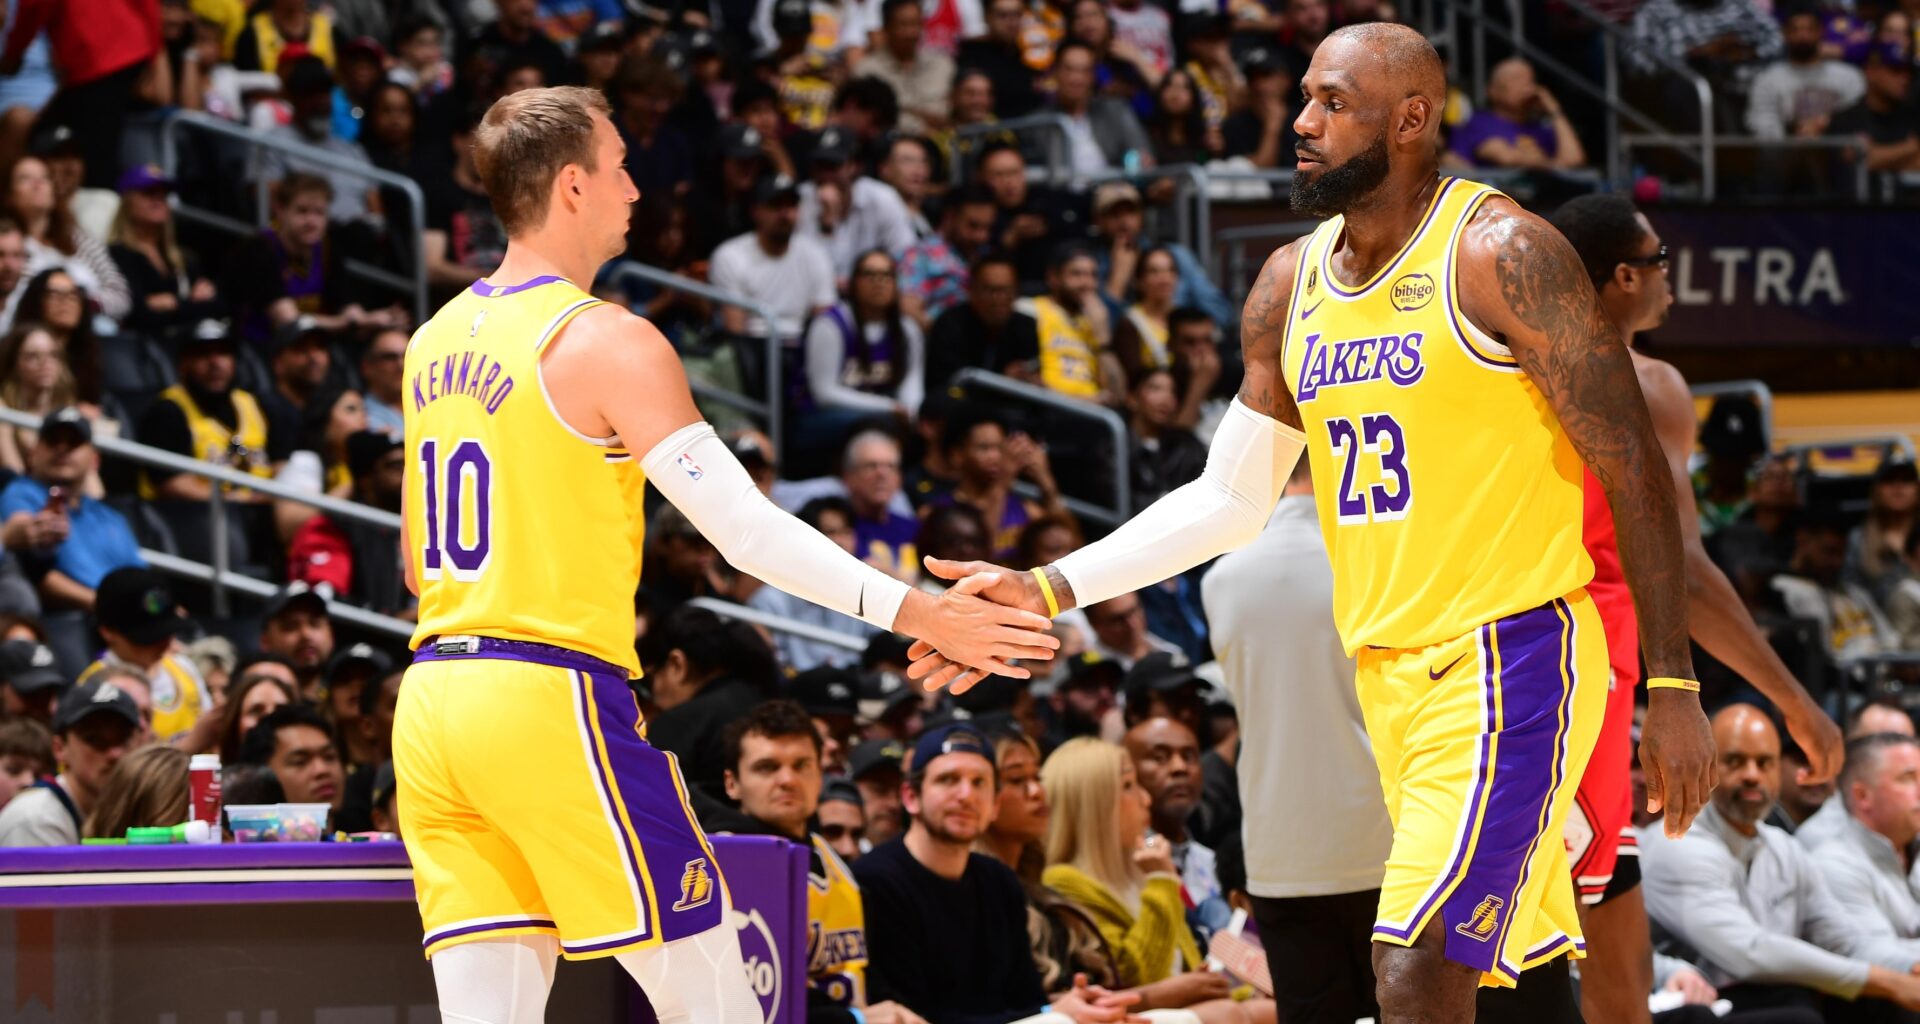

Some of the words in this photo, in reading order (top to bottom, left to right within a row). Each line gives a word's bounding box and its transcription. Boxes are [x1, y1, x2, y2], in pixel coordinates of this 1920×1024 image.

[1394, 283, 1433, 299] bibigo
[1676, 248, 1848, 304] LTRA
[413, 351, 514, 415] KENNARD
[1296, 331, 1425, 404] LAKERS
[1324, 412, 1413, 525] 23
[419, 437, 493, 582] 10
